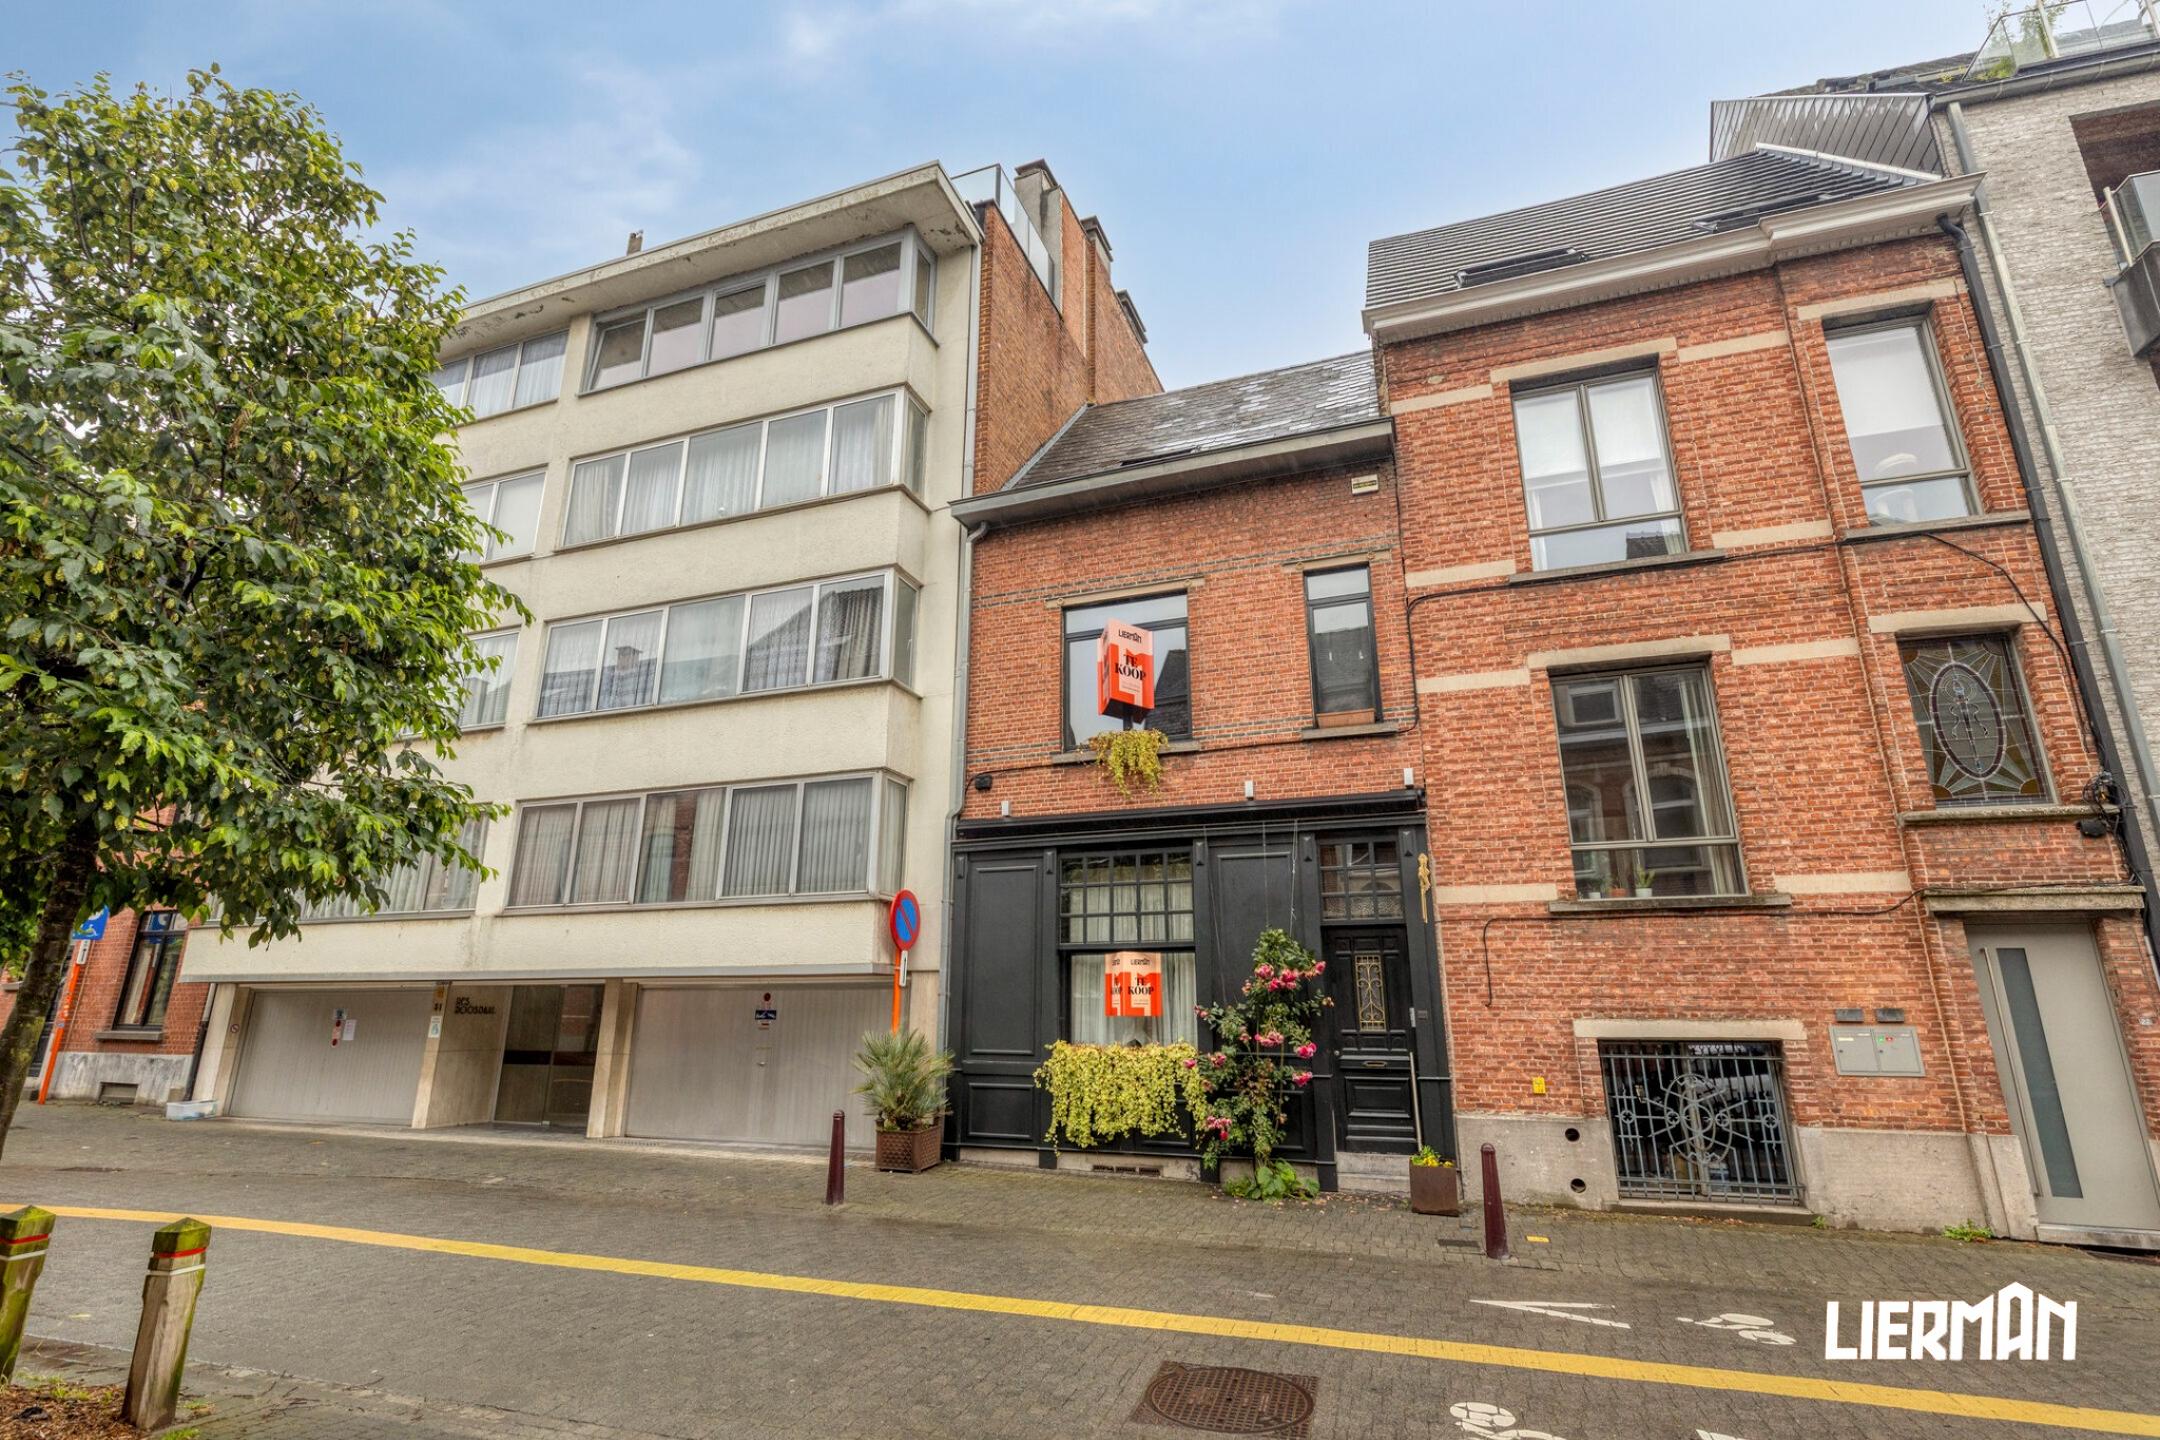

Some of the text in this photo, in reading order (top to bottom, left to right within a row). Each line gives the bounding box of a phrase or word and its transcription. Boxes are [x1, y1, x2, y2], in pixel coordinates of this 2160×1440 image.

[1118, 628, 1142, 644] LIERMAN
[1123, 654, 1138, 667] TE
[1115, 662, 1147, 681] KOOP
[1135, 977, 1147, 986] TE
[1128, 986, 1154, 995] KOOP
